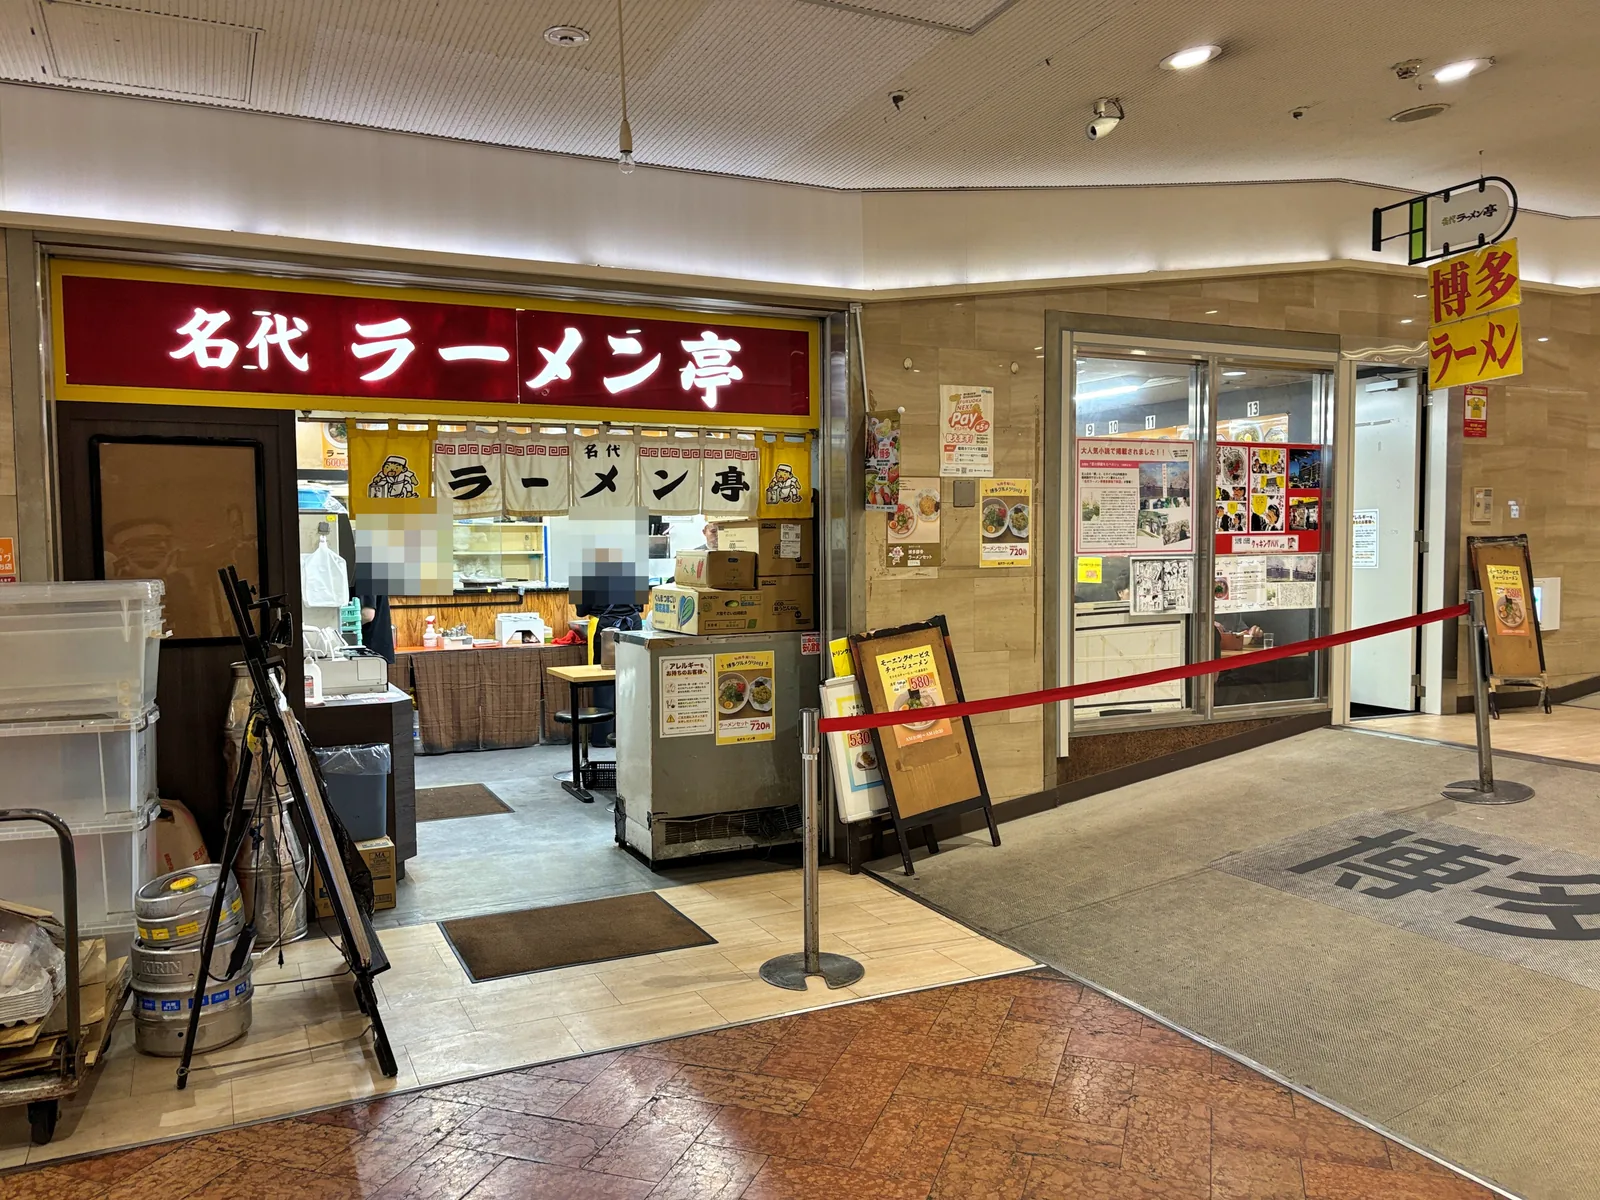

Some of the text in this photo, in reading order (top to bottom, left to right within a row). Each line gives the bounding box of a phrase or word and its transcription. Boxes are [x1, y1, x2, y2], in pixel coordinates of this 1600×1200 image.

[1431, 251, 1517, 323] 博多
[1431, 321, 1518, 384] ラーメン
[1249, 402, 1258, 416] 13
[1087, 424, 1093, 435] 9
[1109, 421, 1118, 433] 10
[1146, 416, 1154, 430] 11
[584, 443, 621, 460] 名代
[447, 464, 751, 502] ラーメン亭
[1009, 548, 1027, 556] 720円
[880, 650, 930, 667] モーニングサービス
[669, 662, 704, 670] アレルギーを
[885, 658, 929, 674] チャーシューメン
[666, 669, 708, 677] お持ちのお客様へ
[719, 721, 749, 729] ラーメンセット
[750, 721, 771, 731] 720円
[142, 961, 182, 974] KIRIN
